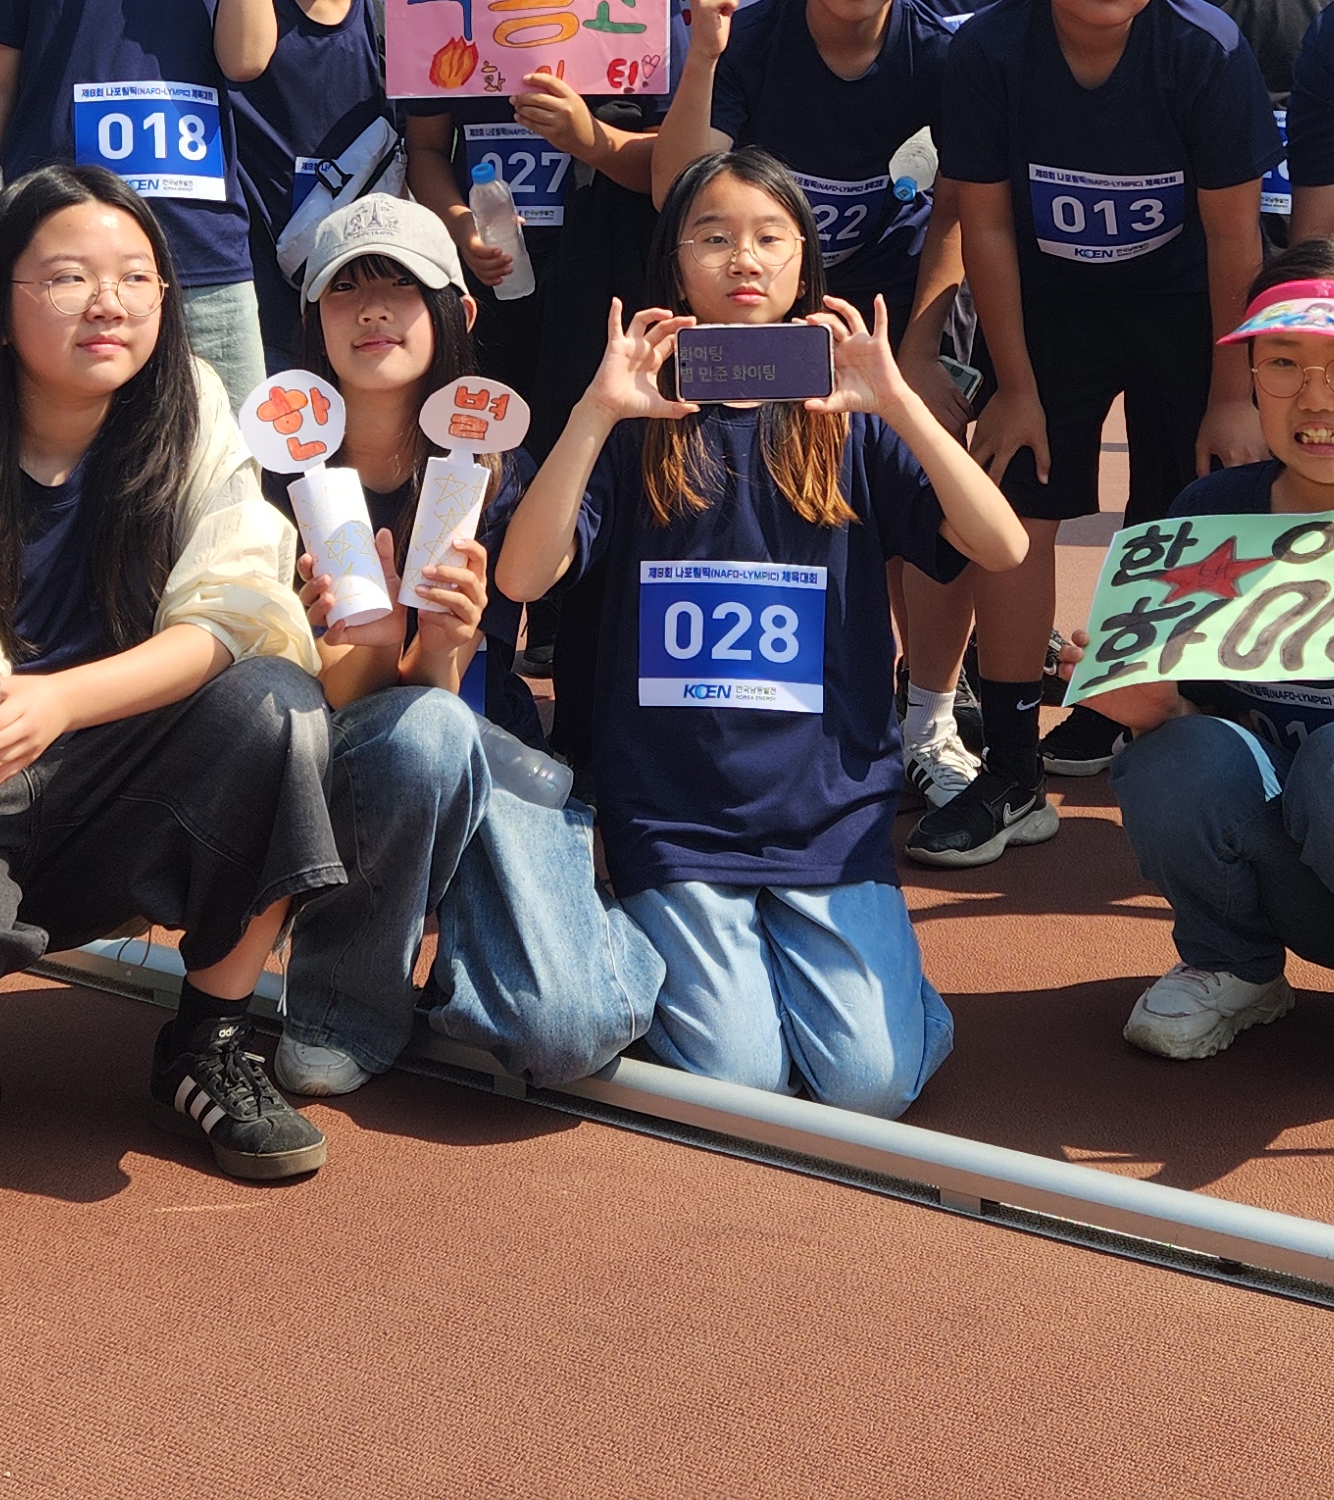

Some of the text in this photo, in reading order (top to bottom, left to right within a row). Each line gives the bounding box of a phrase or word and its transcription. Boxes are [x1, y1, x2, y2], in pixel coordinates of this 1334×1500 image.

[97, 112, 208, 161] 018
[480, 151, 572, 193] 027
[811, 204, 868, 242] 22
[1051, 195, 1165, 235] 013
[1074, 247, 1114, 259] KOEN
[679, 345, 723, 362] 화이팅
[698, 366, 729, 382] 민준
[732, 364, 776, 381] 화이팅
[256, 385, 331, 462] 한
[448, 385, 511, 441] 별
[1110, 520, 1199, 587] 한
[647, 567, 673, 578] 제8회
[781, 570, 818, 585] 체육대회
[664, 601, 799, 664] 028
[682, 683, 732, 699] KOEN
